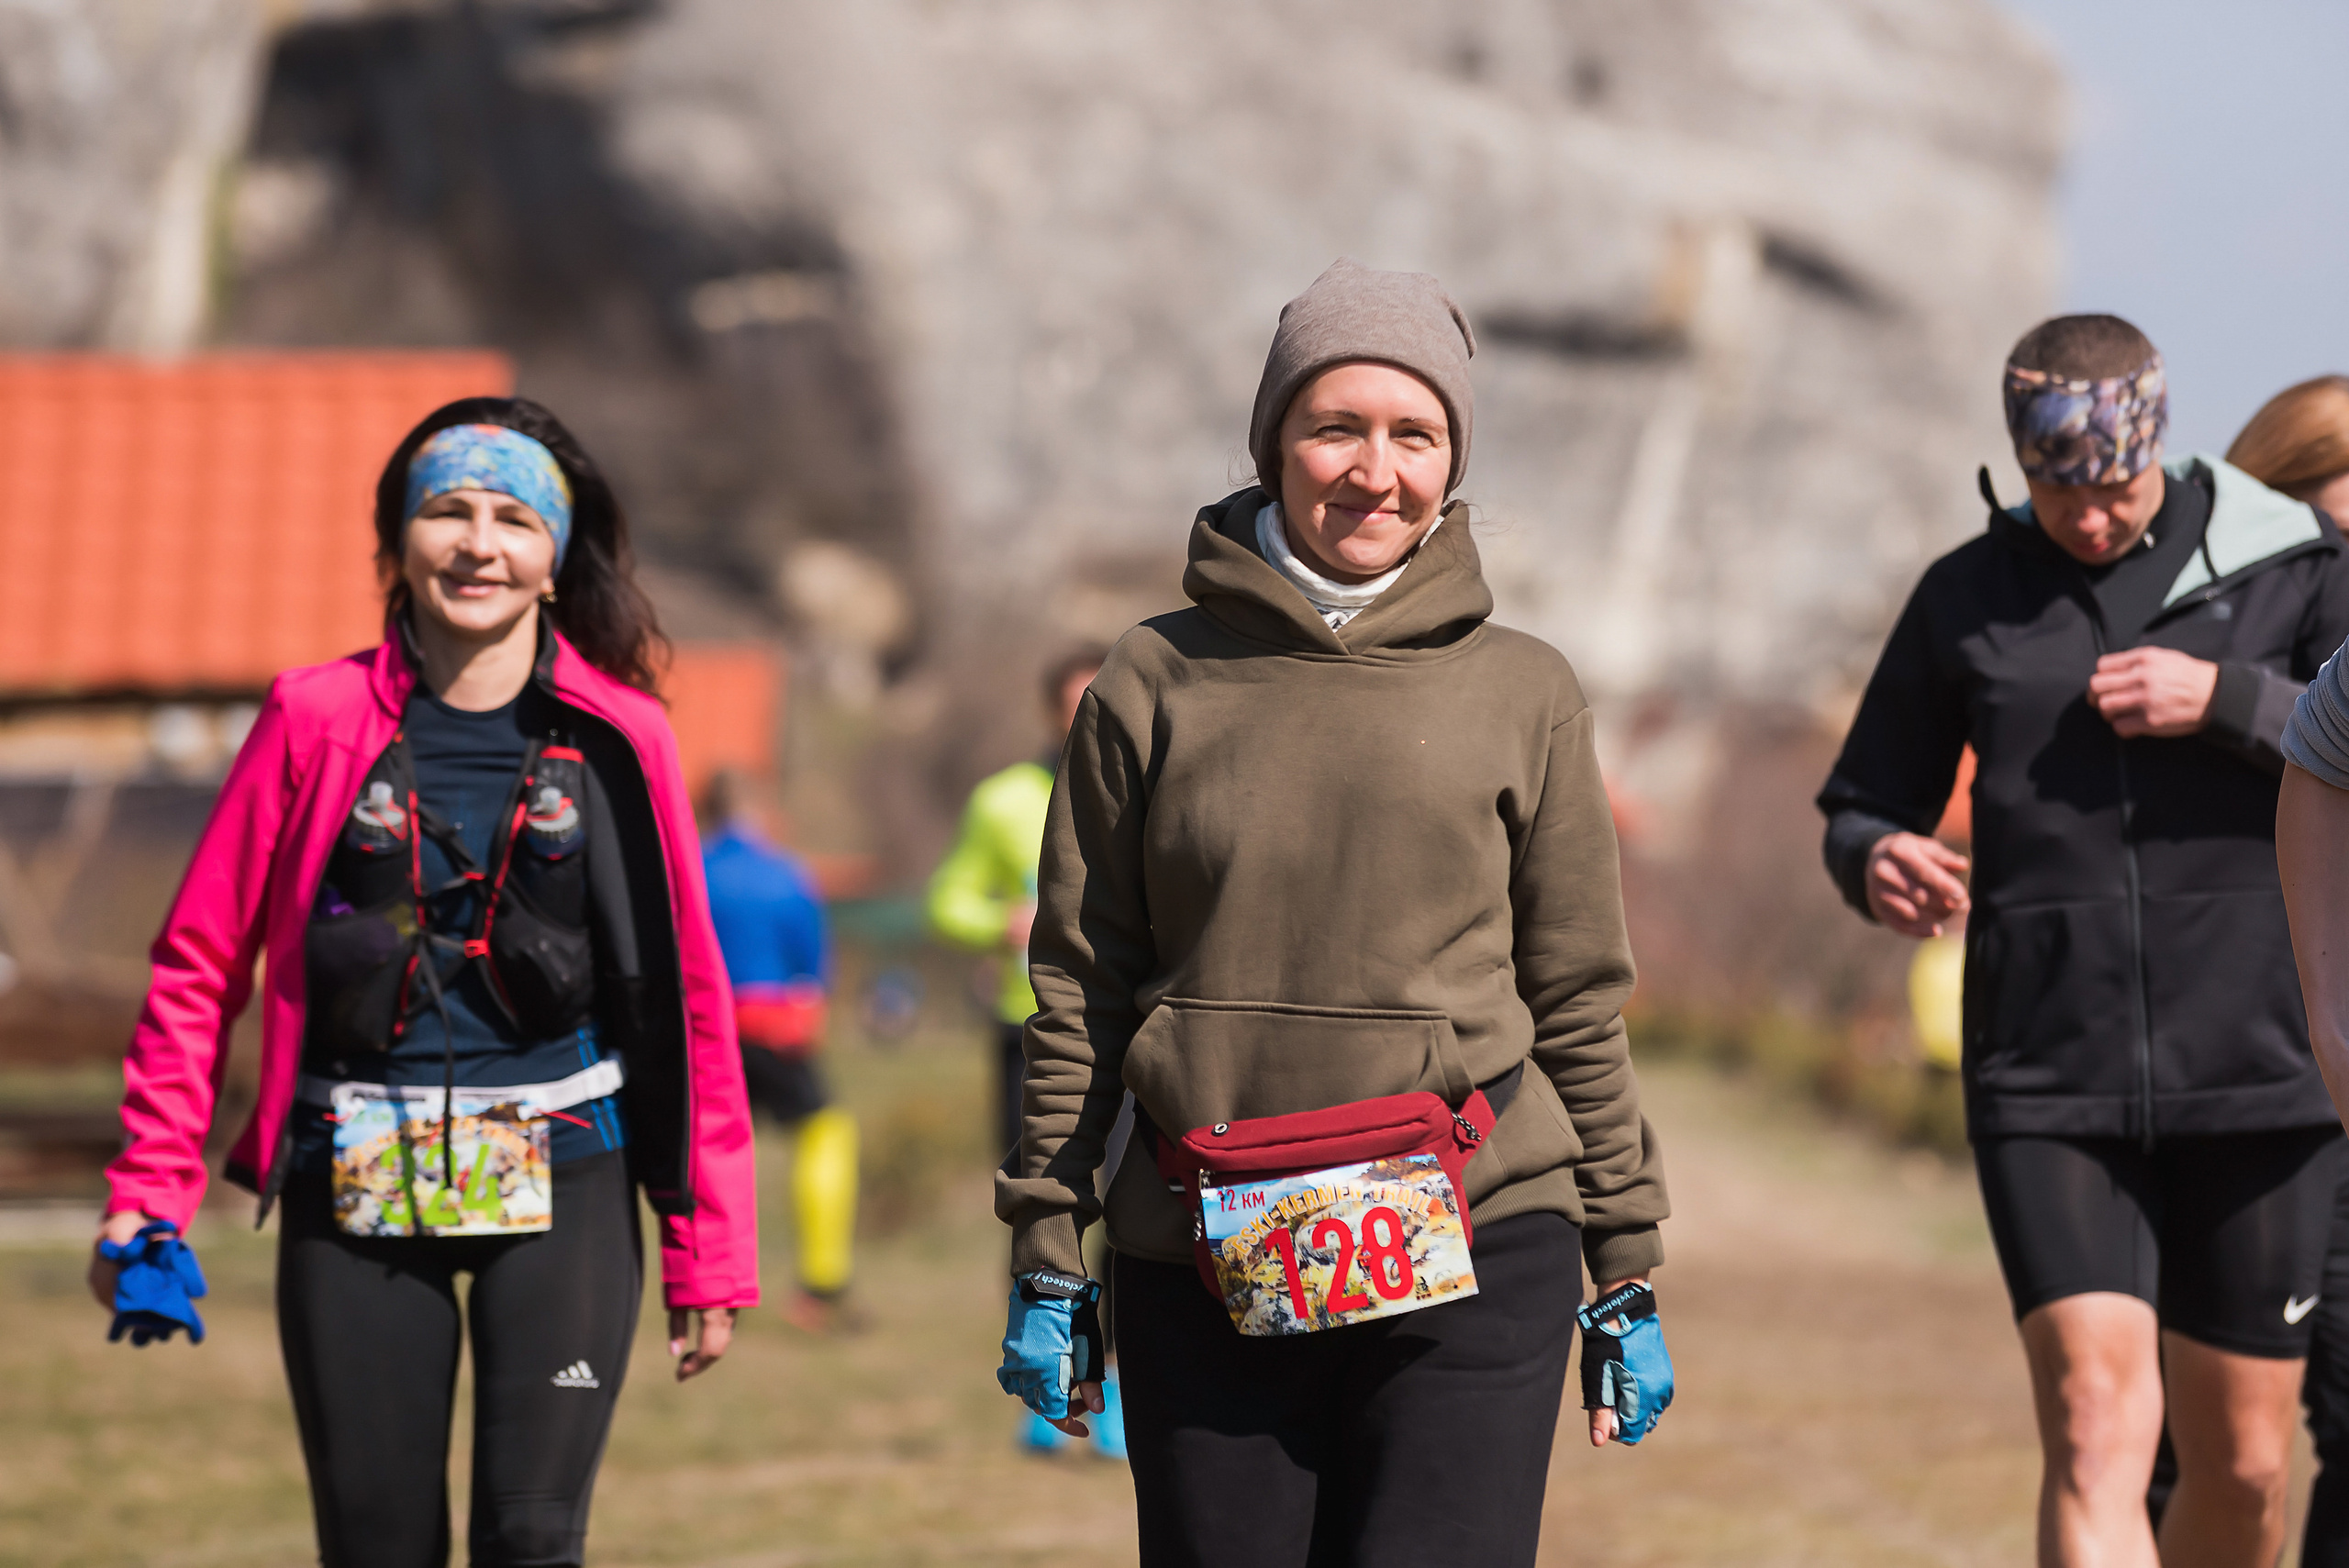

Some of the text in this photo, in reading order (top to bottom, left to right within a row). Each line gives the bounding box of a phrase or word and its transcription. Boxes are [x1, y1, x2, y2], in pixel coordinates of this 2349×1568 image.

[1217, 1188, 1237, 1213] 12
[1231, 1180, 1431, 1256] ESKI-KERMEN TRAIL
[1264, 1207, 1414, 1319] 128
[1041, 1274, 1088, 1293] cyclotech
[1591, 1289, 1635, 1319] cyclotech
